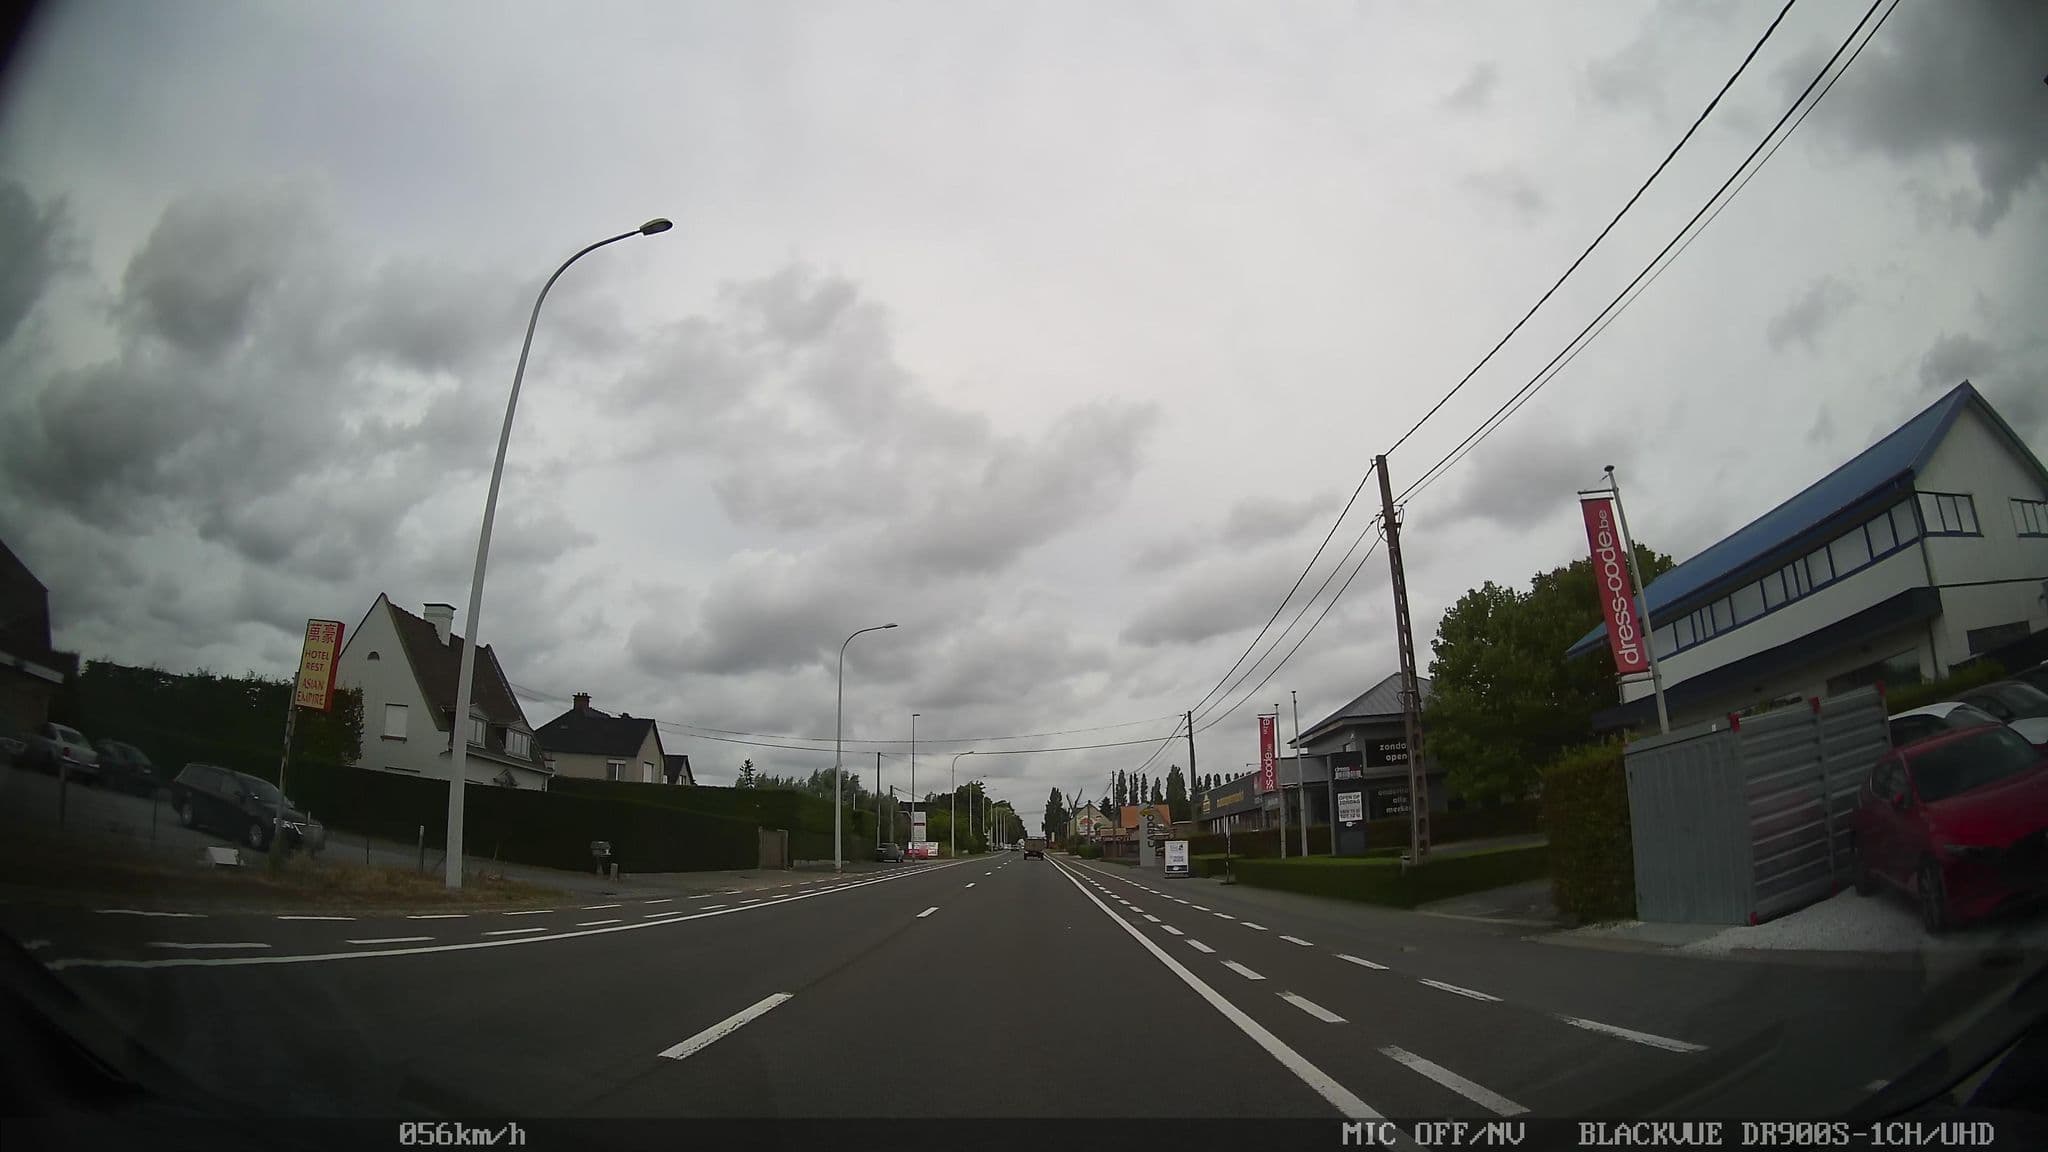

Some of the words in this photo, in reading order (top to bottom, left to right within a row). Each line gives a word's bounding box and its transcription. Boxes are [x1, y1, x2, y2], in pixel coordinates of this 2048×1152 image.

[1596, 509, 1639, 665] dress-code.be
[304, 650, 329, 660] HOTEL
[303, 678, 324, 690] ASIAN
[296, 691, 324, 705] EMPIRE
[1385, 753, 1408, 762] open
